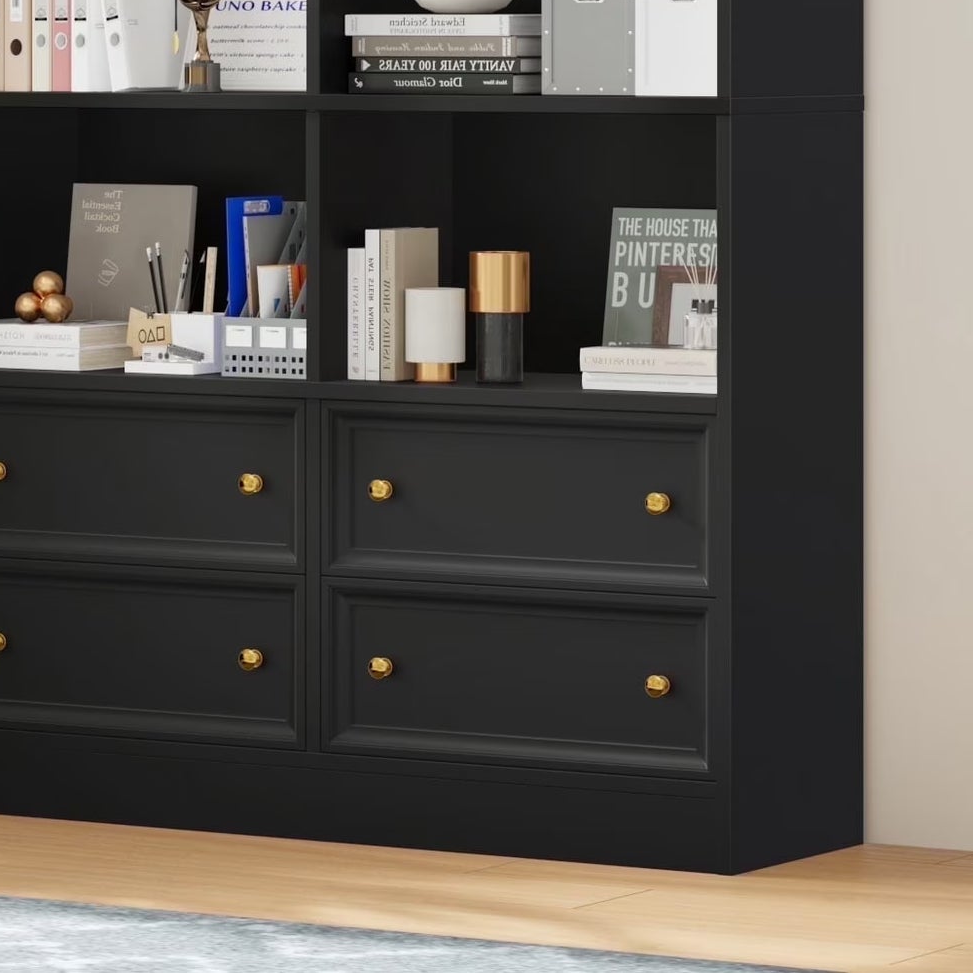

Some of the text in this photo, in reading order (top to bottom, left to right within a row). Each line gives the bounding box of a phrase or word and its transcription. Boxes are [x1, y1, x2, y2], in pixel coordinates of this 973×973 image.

[260, 0, 306, 12] BAKE
[618, 217, 717, 238] THE HOUSE THA
[614, 241, 717, 267] PINTERES
[611, 271, 657, 309] BU
